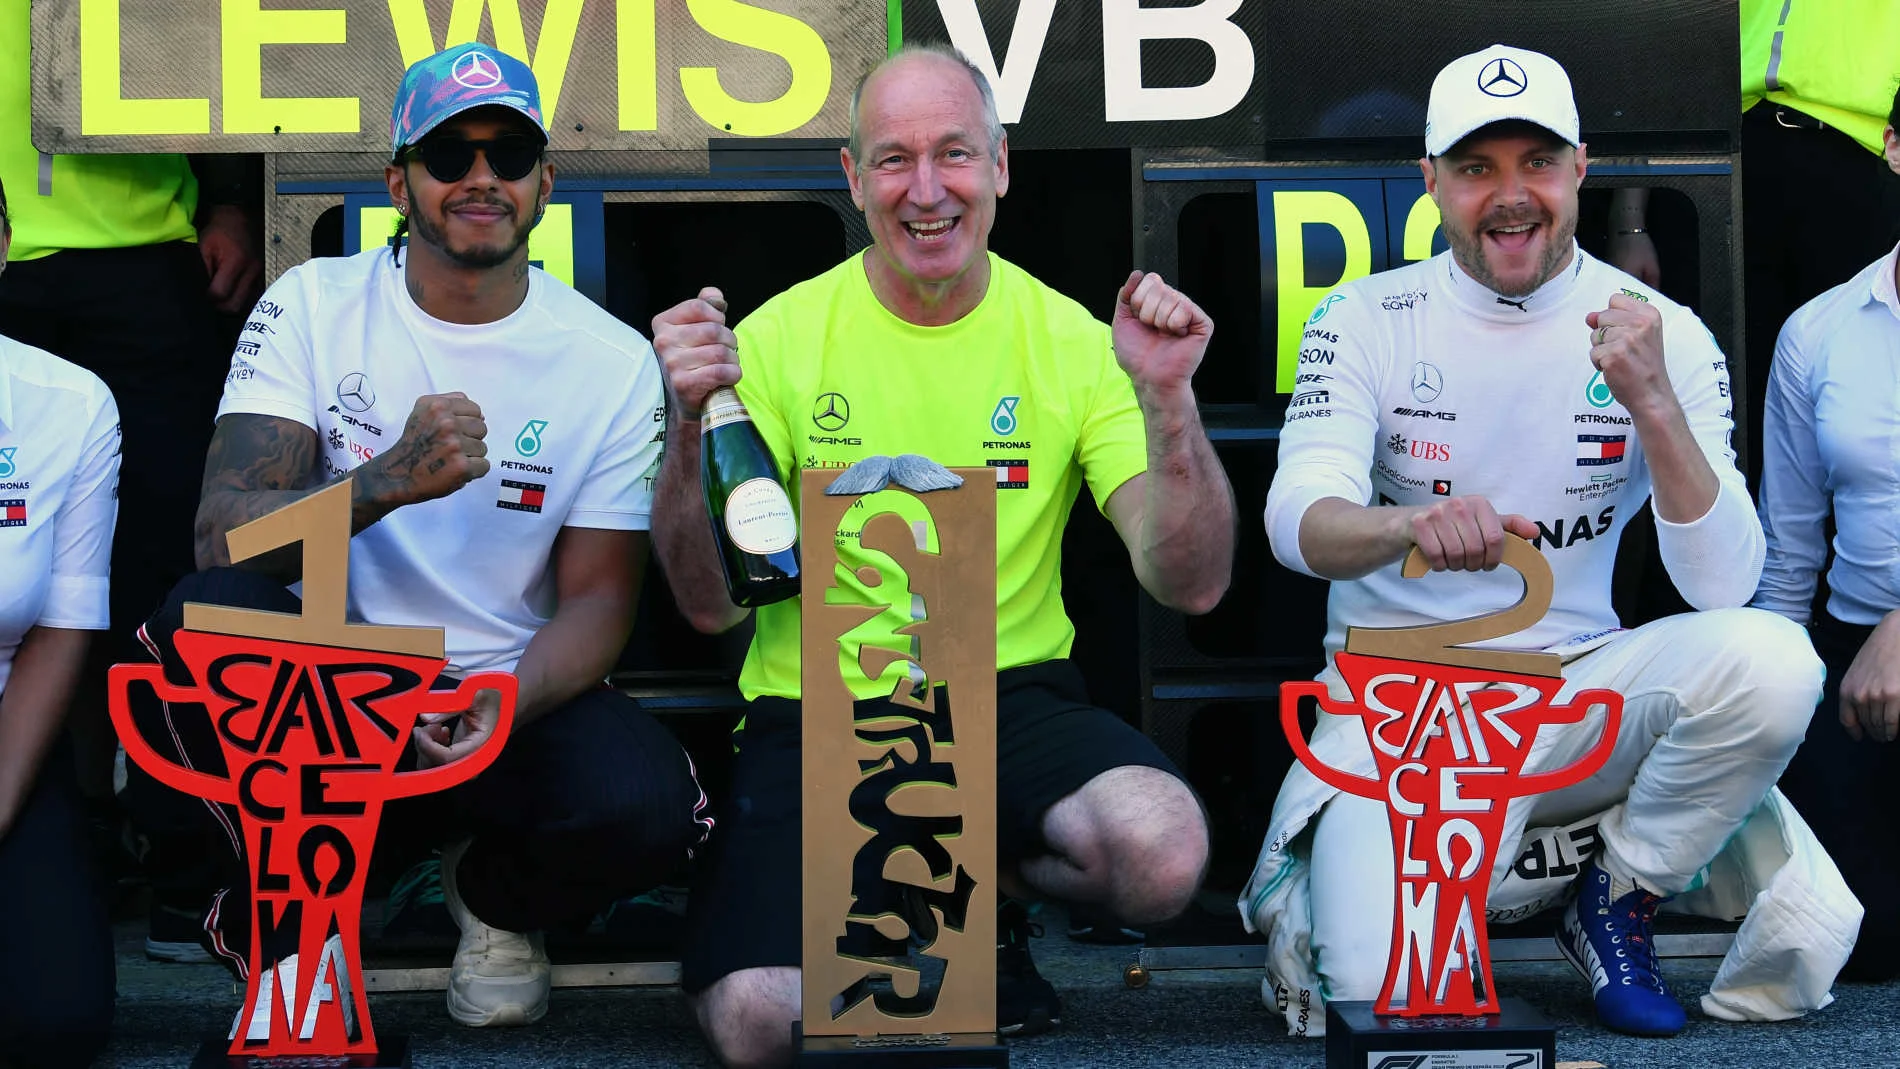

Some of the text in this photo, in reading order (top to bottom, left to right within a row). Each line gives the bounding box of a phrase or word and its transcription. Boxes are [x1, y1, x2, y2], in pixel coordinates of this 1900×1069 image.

[257, 300, 284, 319] SON
[1303, 329, 1340, 343] RONAS
[1298, 348, 1335, 366] SON
[1410, 410, 1457, 421] AMG
[1574, 414, 1632, 426] PETRONAS
[817, 437, 862, 446] AMG
[982, 441, 1032, 449] PETRONAS
[1411, 439, 1451, 462] UBS
[501, 460, 554, 475] PETRONAS
[1377, 460, 1426, 487] Qualcomm
[0, 482, 30, 490] RONAS
[1565, 482, 1601, 496] Hewlett
[835, 530, 861, 539] ckard
